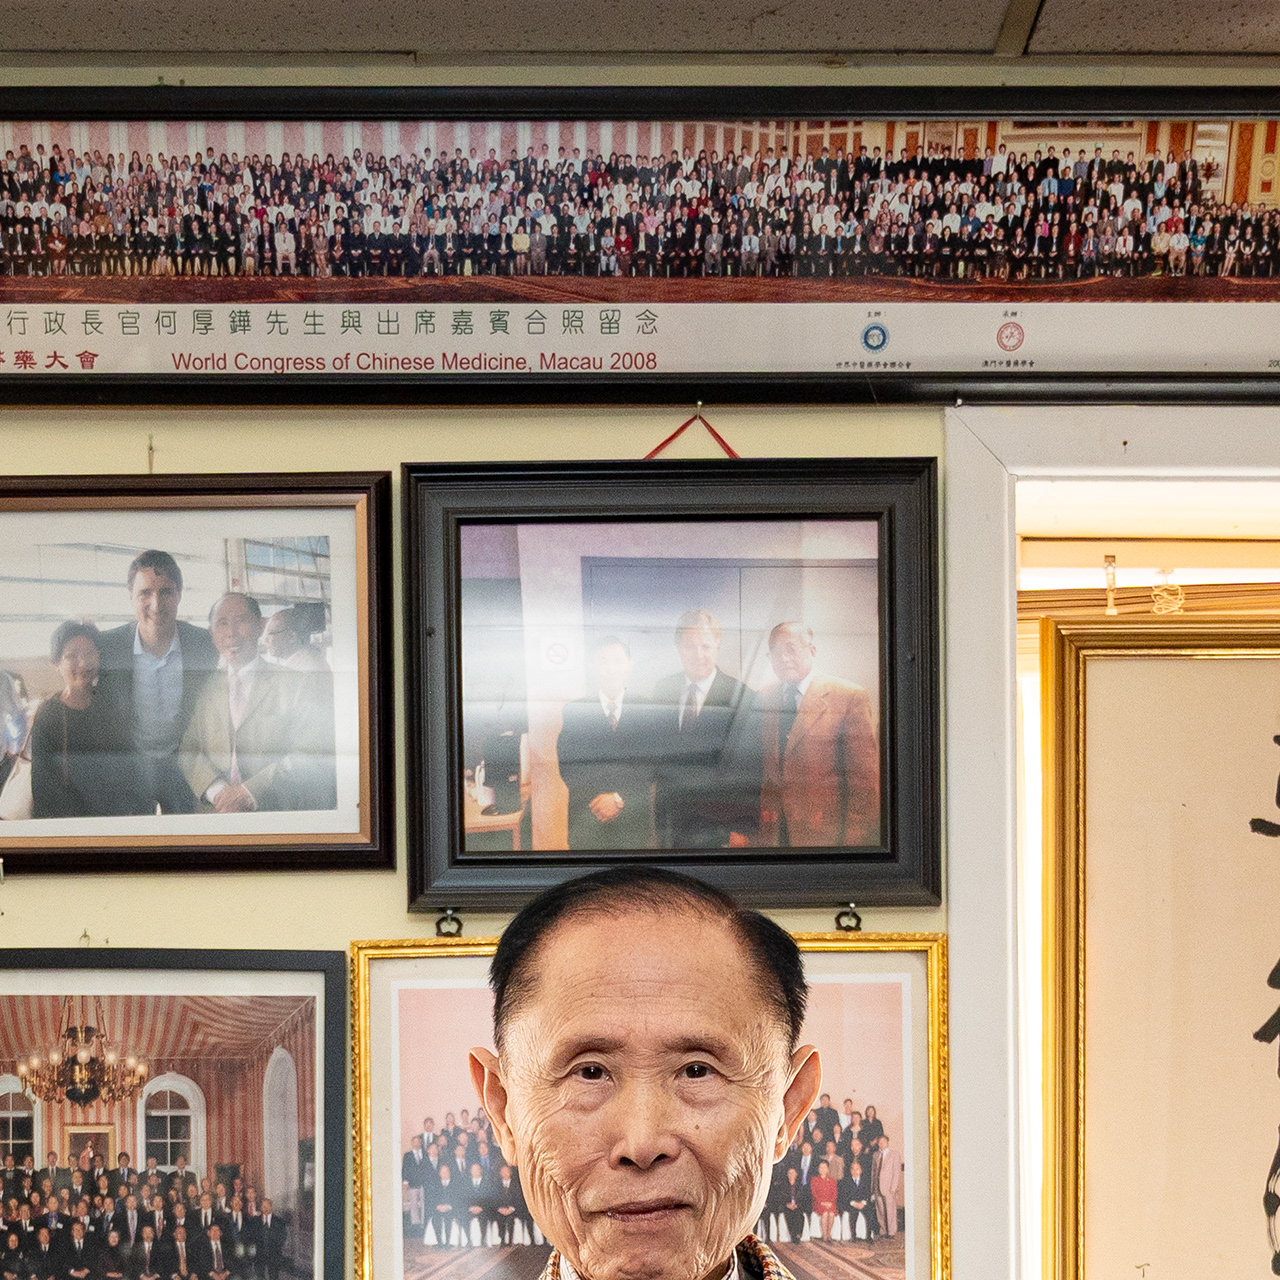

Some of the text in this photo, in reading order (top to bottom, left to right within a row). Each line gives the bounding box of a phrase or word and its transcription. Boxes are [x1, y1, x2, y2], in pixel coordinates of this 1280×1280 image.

[172, 352, 658, 374] World Congress of Chinese Medicine, Macau 2008
